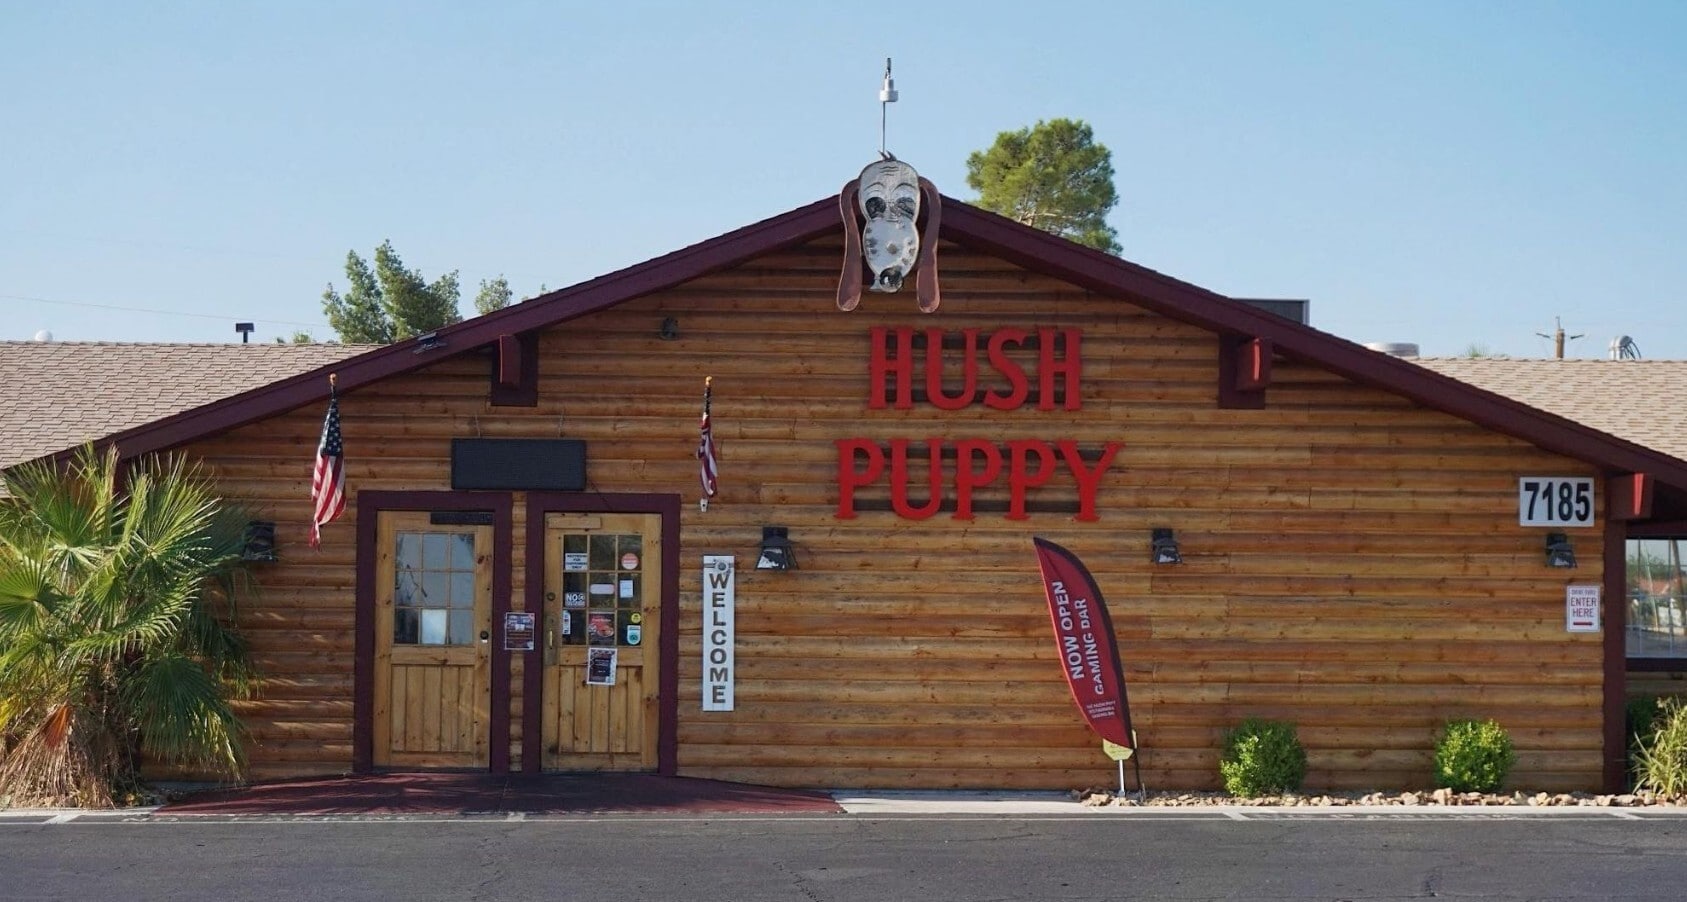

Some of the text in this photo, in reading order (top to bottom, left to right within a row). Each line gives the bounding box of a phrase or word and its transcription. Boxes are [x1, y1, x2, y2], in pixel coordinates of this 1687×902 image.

[867, 325, 1084, 411] HUSH
[833, 437, 1126, 522] PUPPY
[1525, 482, 1590, 521] 7185
[709, 573, 730, 704] WELCOME
[1052, 582, 1084, 680] NOW OPEN
[1570, 597, 1597, 607] ENTER
[1572, 607, 1594, 618] HERE
[1083, 632, 1104, 695] GAMING
